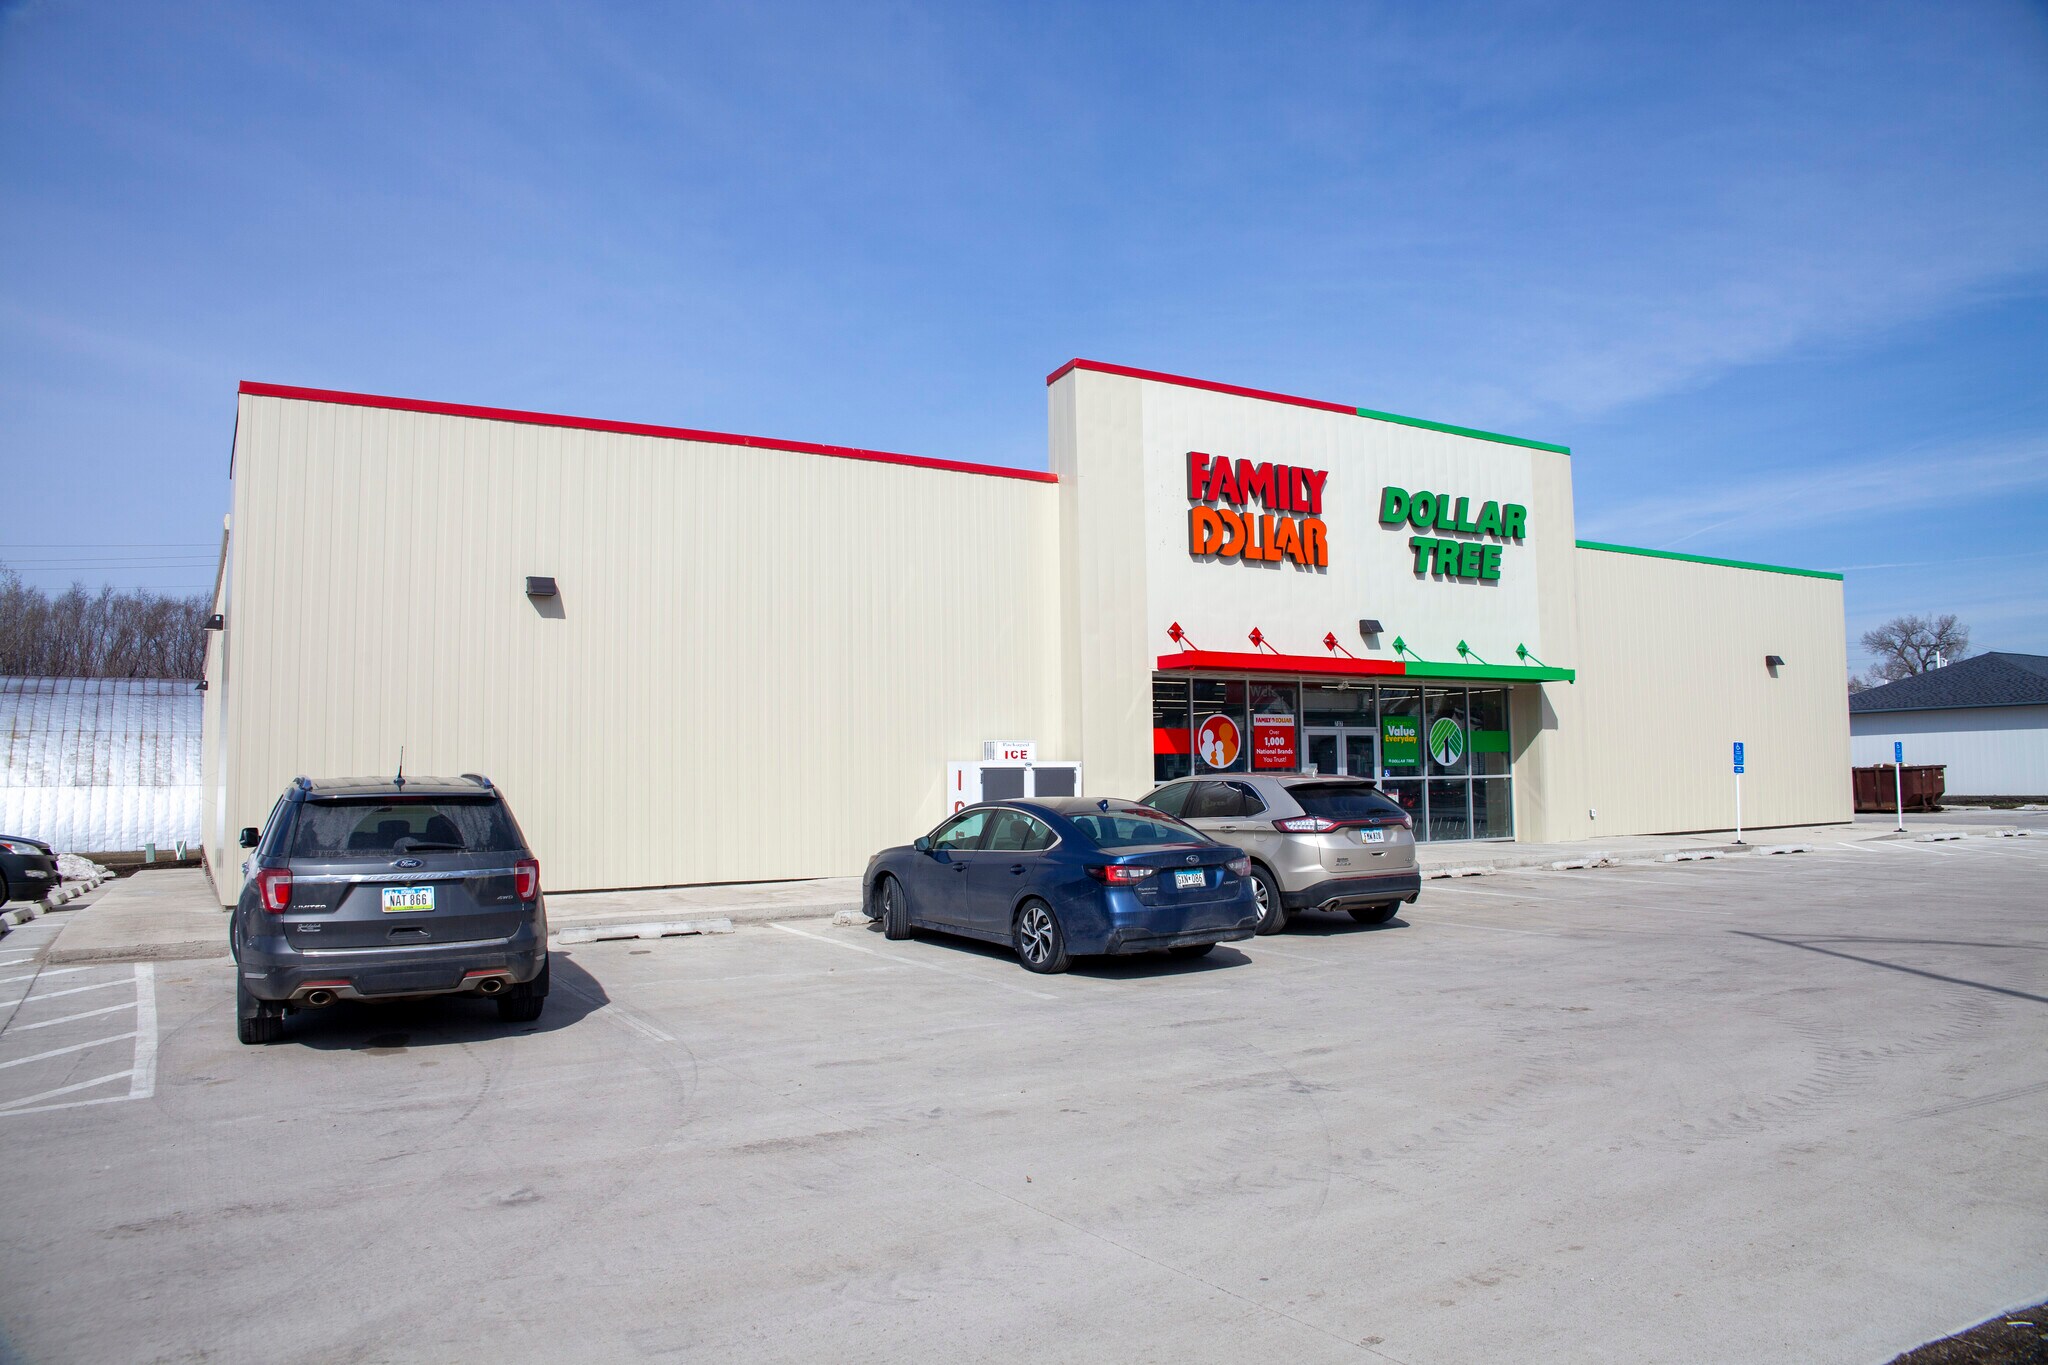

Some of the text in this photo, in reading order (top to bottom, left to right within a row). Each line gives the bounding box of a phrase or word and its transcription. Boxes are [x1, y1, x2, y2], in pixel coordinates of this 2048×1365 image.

[1186, 451, 1328, 515] FAMILY
[1379, 486, 1527, 539] DOLLAR
[1188, 505, 1328, 567] DOLLAR
[1409, 535, 1502, 580] TREE
[1387, 725, 1415, 736] Value
[1264, 737, 1285, 747] 1,000
[1385, 734, 1418, 744] Everyday
[1004, 750, 1028, 760] ICE
[390, 893, 427, 906] NAT 866
